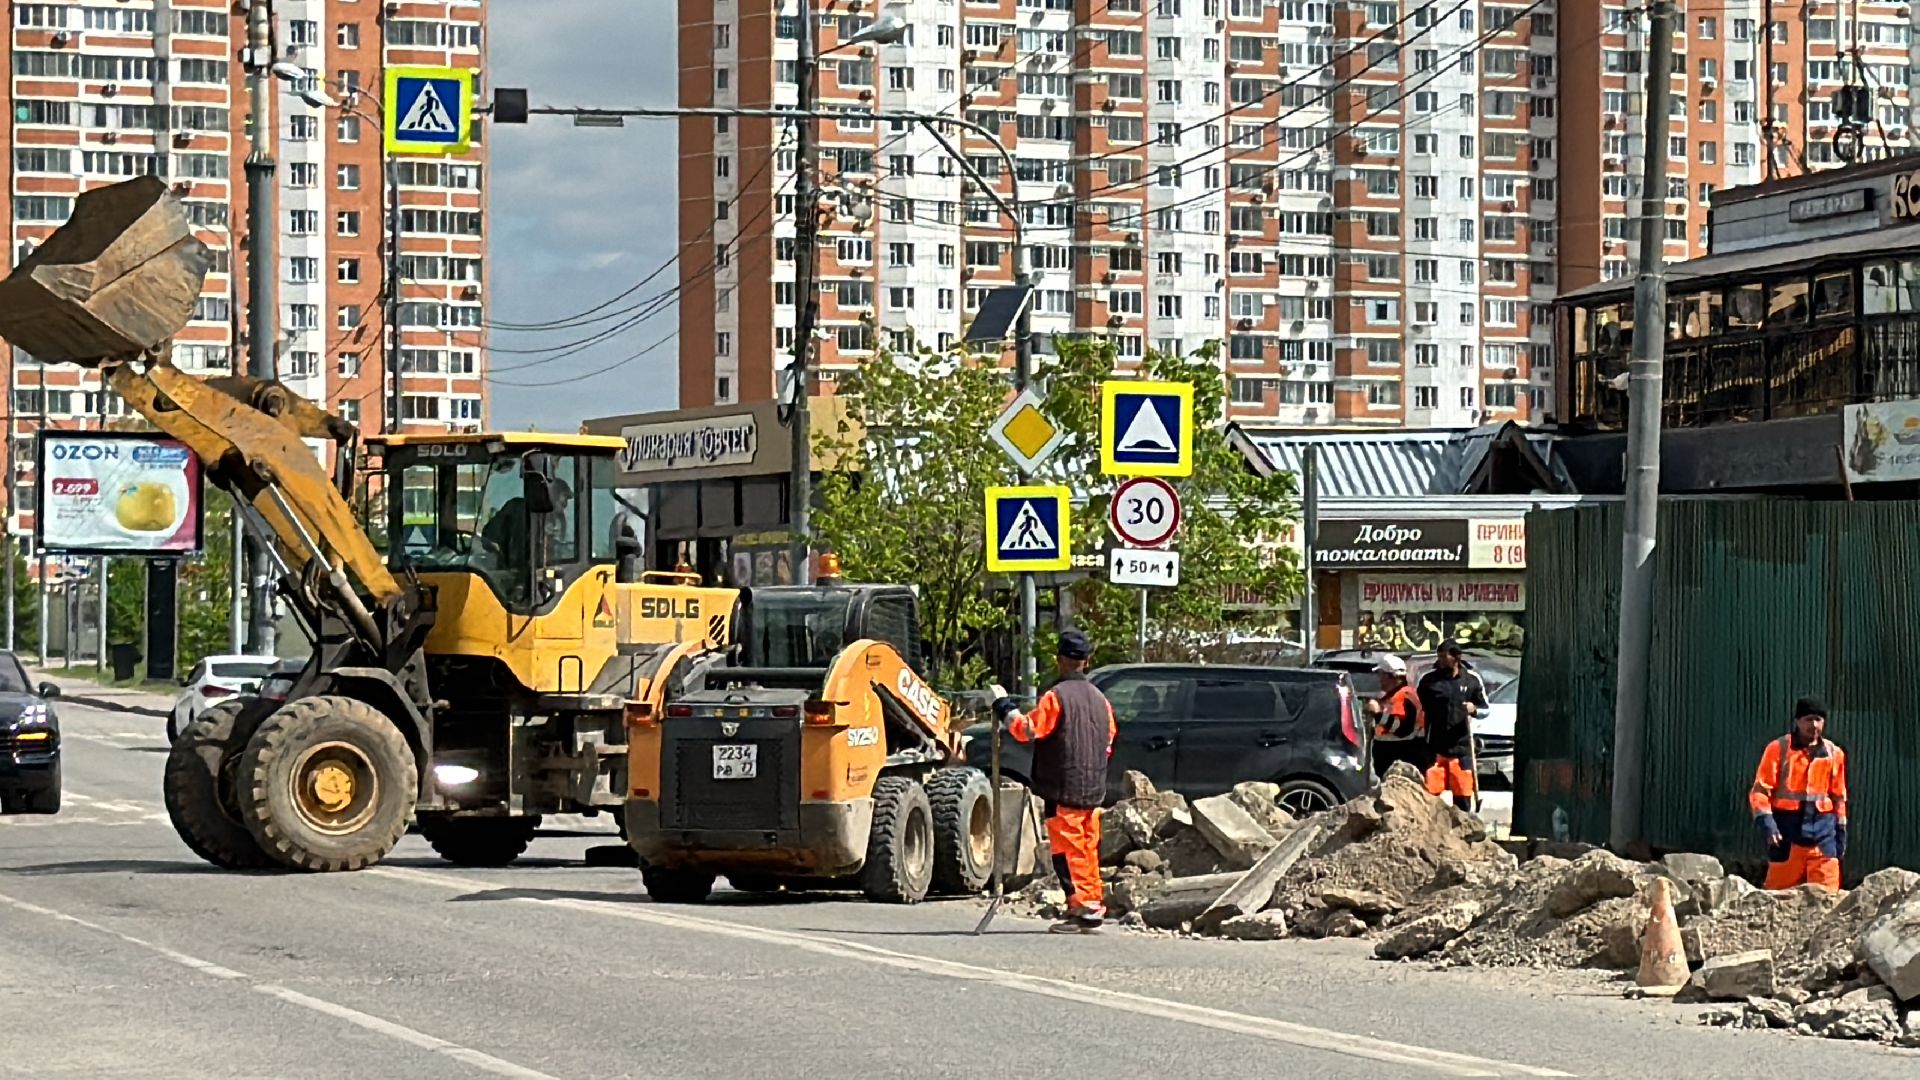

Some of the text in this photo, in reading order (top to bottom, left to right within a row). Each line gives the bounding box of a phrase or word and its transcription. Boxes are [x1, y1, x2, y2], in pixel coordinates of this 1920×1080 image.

[52, 445, 119, 460] OZON
[1127, 497, 1164, 524] 30
[1354, 525, 1422, 545] Добро
[1315, 544, 1462, 562] пожаловать!
[1494, 545, 1503, 563] 8
[1129, 560, 1160, 573] 50 м
[1364, 582, 1520, 603] ПРОДУКТЫ из АРМЕНИИ
[641, 598, 699, 618] SDLG
[897, 667, 941, 726] CASE
[719, 746, 751, 760] 2234
